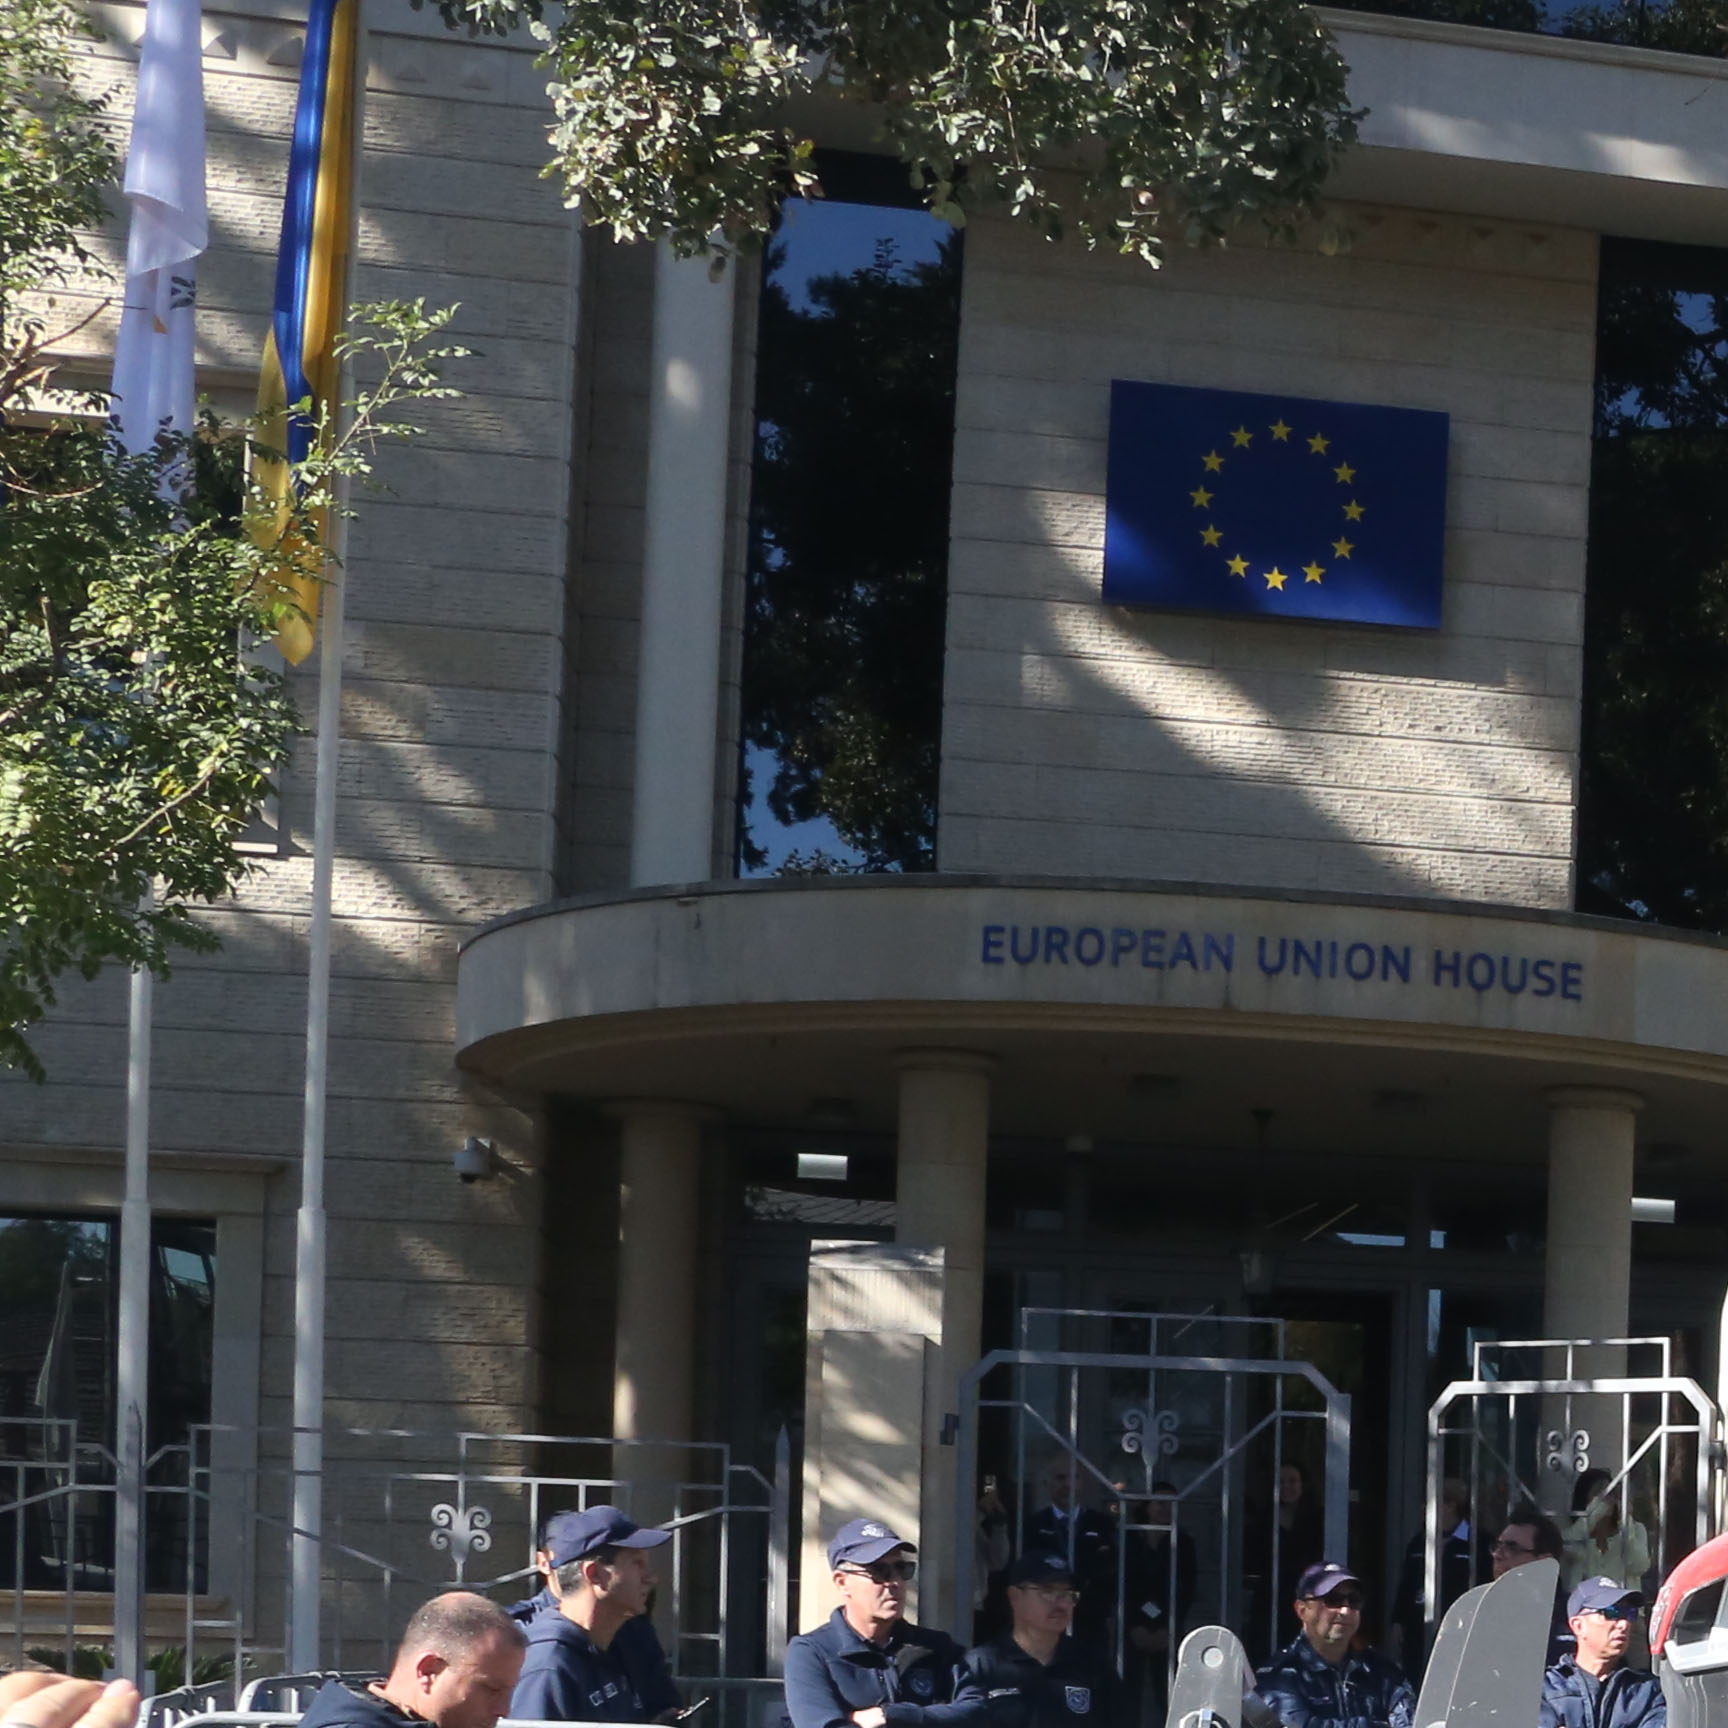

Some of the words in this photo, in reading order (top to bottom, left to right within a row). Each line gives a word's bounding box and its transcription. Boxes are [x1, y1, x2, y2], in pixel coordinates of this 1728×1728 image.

[981, 924, 1234, 972] EUROPEAN
[1258, 936, 1411, 984] UNION
[1433, 950, 1584, 1001] HOUSE
